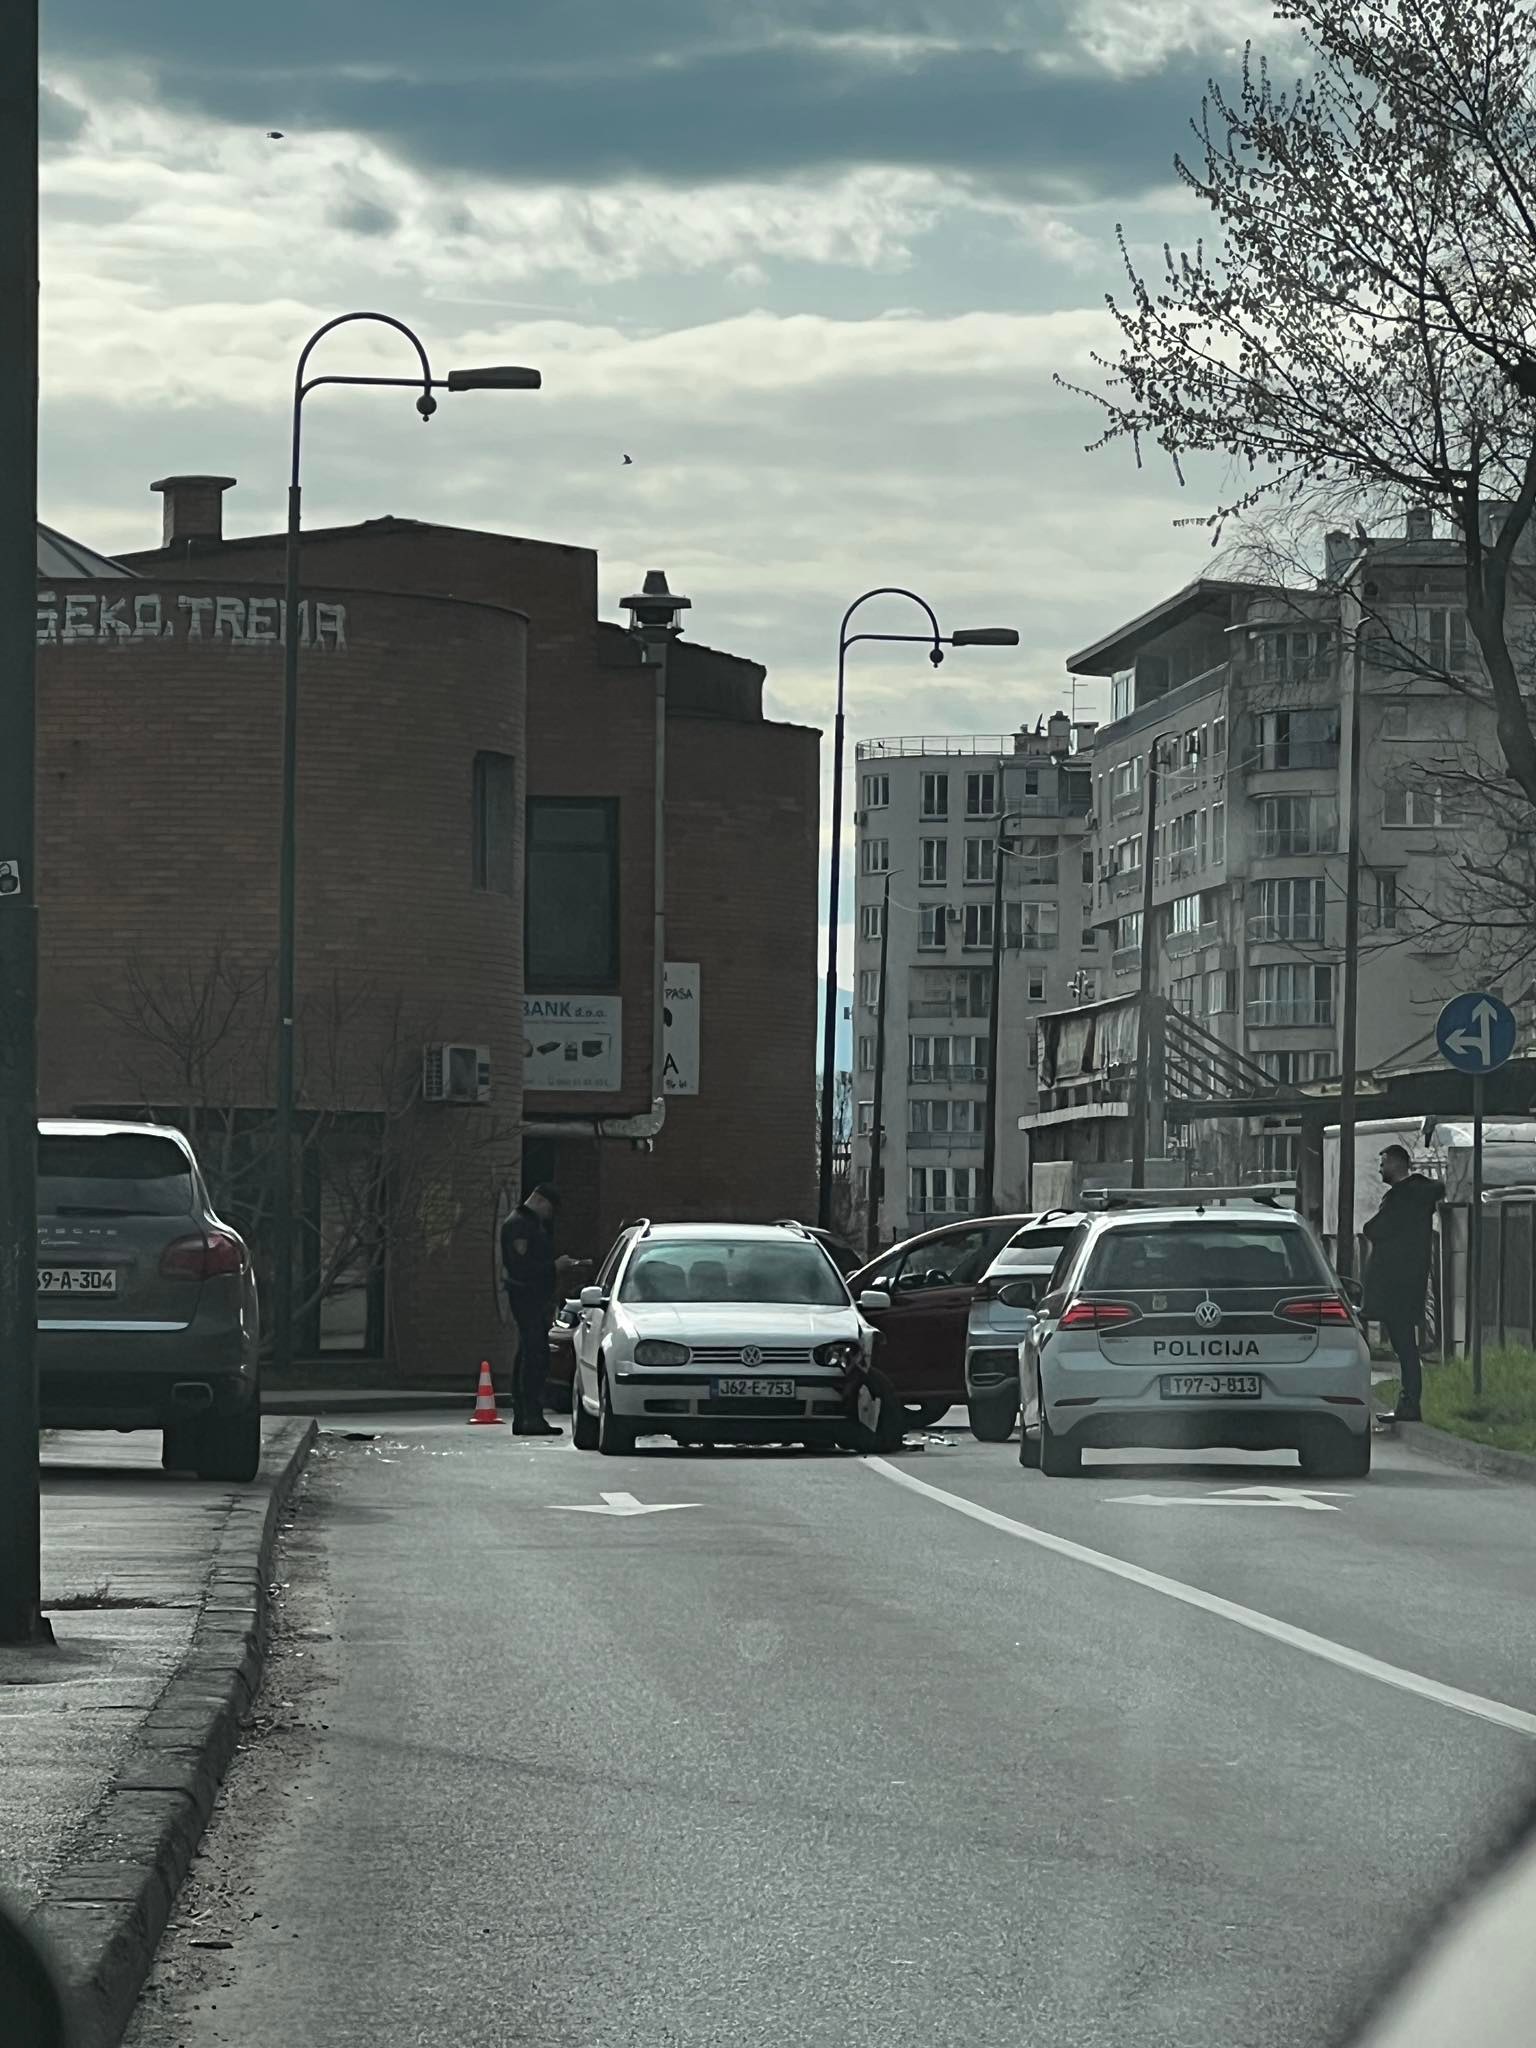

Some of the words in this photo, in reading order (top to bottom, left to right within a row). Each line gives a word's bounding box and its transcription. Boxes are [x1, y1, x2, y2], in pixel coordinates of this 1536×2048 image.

[1153, 1340, 1259, 1356] POLICIJA
[720, 1381, 793, 1395] J62-E-753
[1173, 1377, 1258, 1393] T97-J-813
